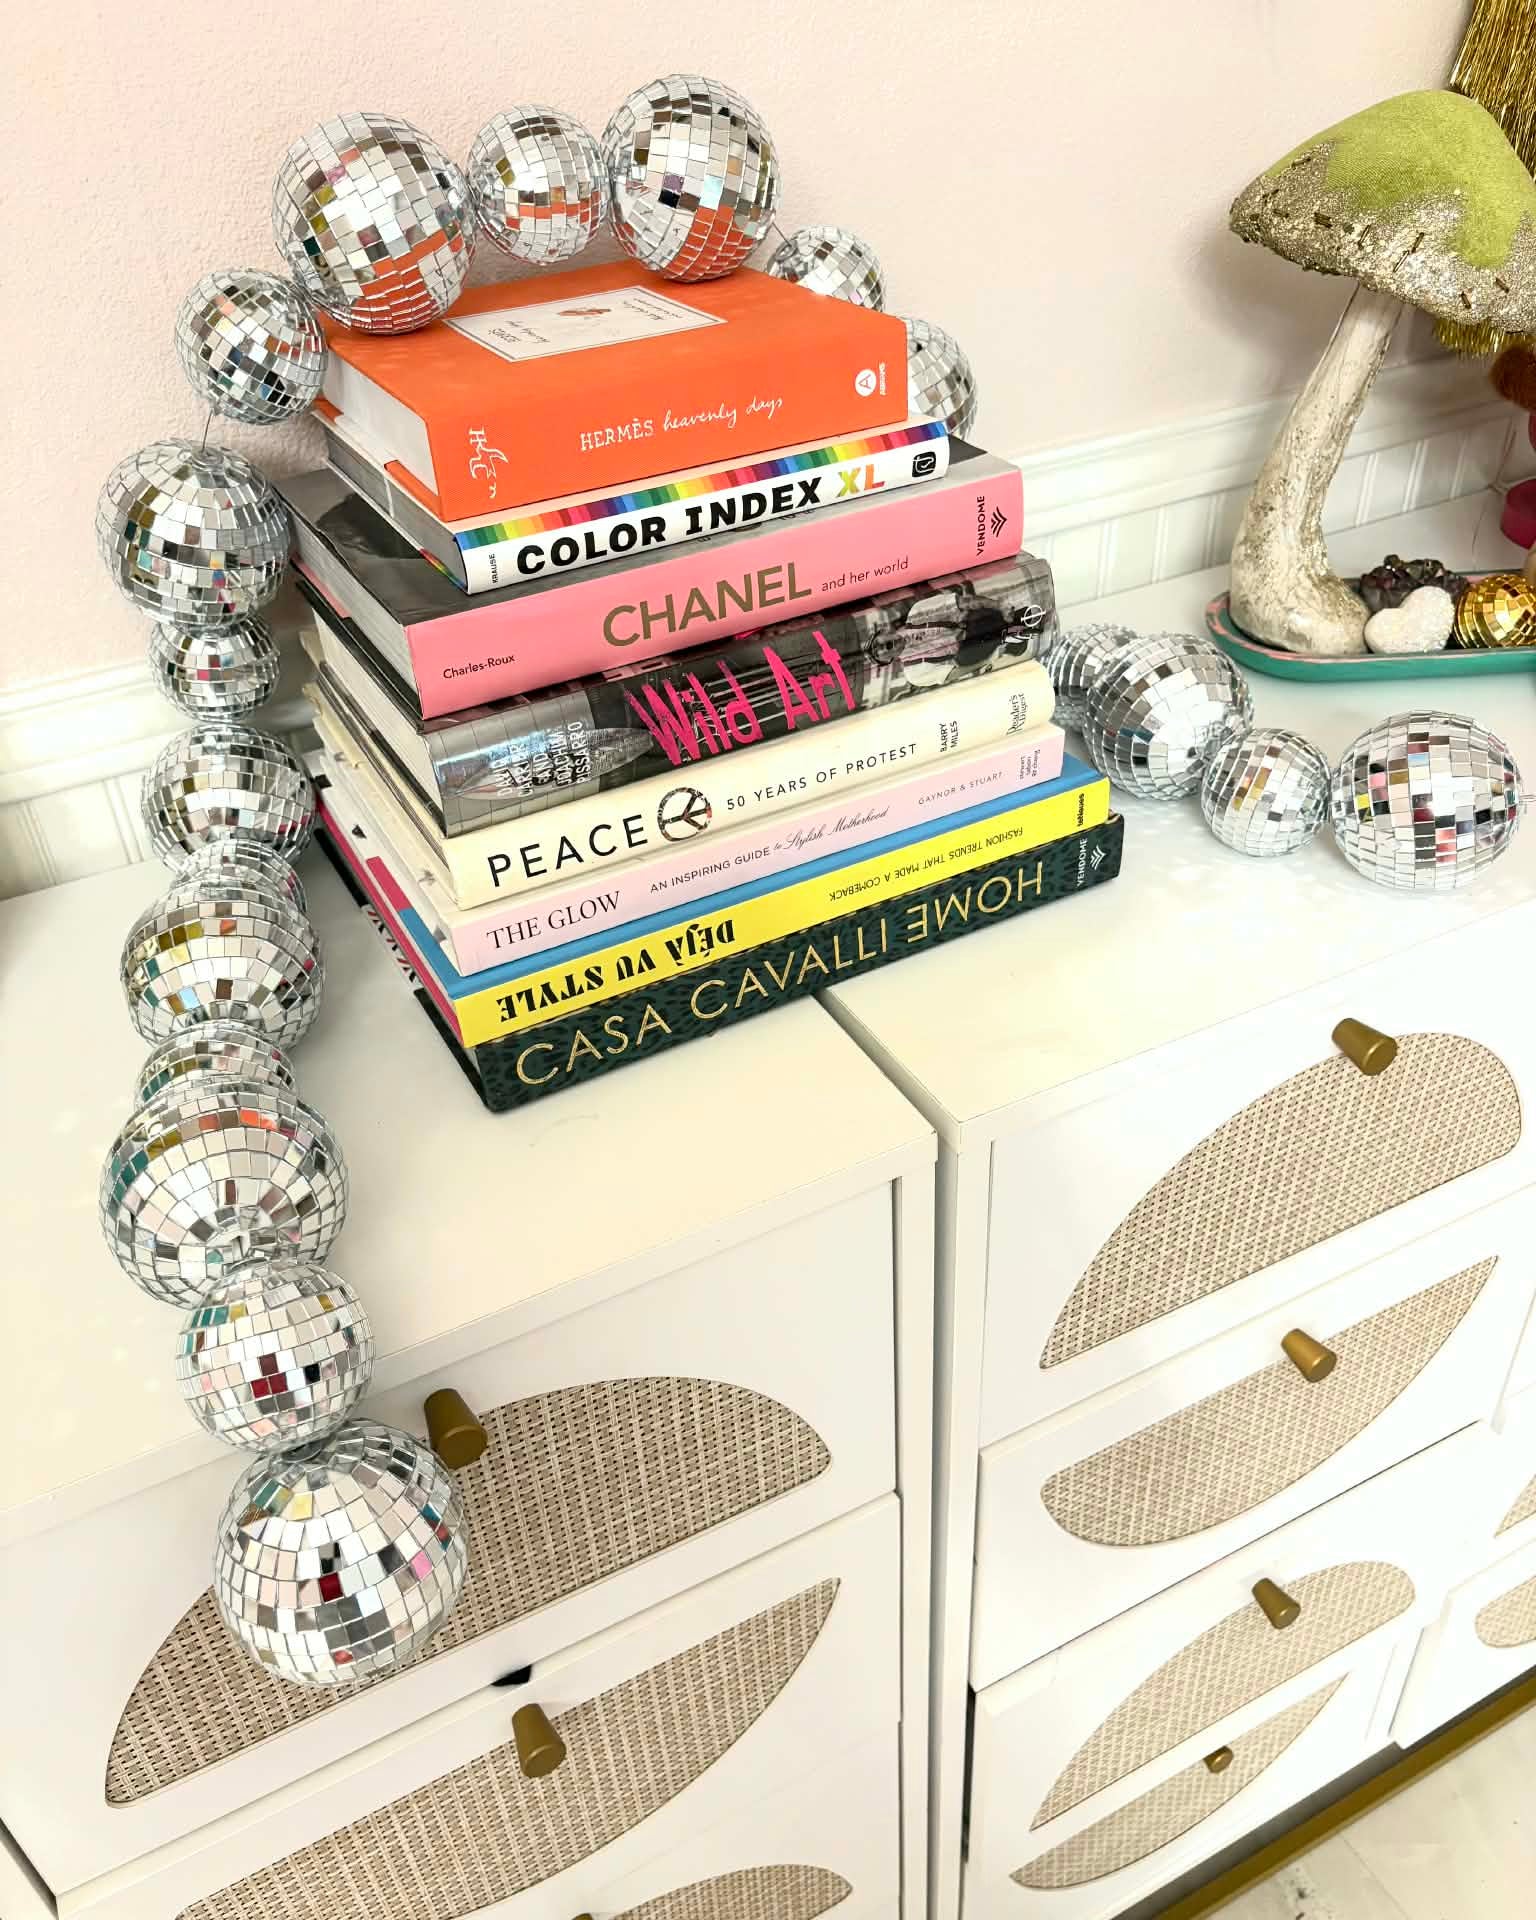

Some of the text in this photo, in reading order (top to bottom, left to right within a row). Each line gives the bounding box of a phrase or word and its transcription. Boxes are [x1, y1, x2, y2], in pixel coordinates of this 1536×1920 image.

[579, 396, 784, 452] HERMÈS heavenly days
[516, 463, 885, 576] COLOR INDEX XL
[974, 494, 986, 556] VENDOME
[489, 552, 498, 585] KRAUSE
[602, 557, 909, 647] CHANEL and her world
[443, 653, 516, 680] Charles-Roux
[623, 630, 856, 766] Wild Art
[567, 721, 592, 784] PISSARRO
[938, 723, 948, 753] BARRY
[950, 720, 959, 749] MILES
[486, 744, 918, 888] PEACE 50 YEARS OF PROTEST
[487, 916, 543, 950] THE
[547, 890, 621, 930] GLOW
[650, 881, 669, 894] AN
[671, 860, 731, 887] INSPIRING
[735, 847, 771, 867] GUIDE
[782, 826, 826, 852] Stylish
[827, 806, 890, 837] Motherhood
[918, 786, 956, 806] GAYNOR
[959, 783, 966, 791] &
[970, 771, 1003, 788] STUART
[829, 826, 1024, 902] FASHION TRENDS THAT MADE A COMEBACK
[1076, 837, 1088, 887] VENDOME
[906, 862, 1043, 942] HOME
[496, 965, 604, 1023] STYLE
[616, 948, 657, 982] VU
[516, 926, 888, 1085] CASA CAVALLI
